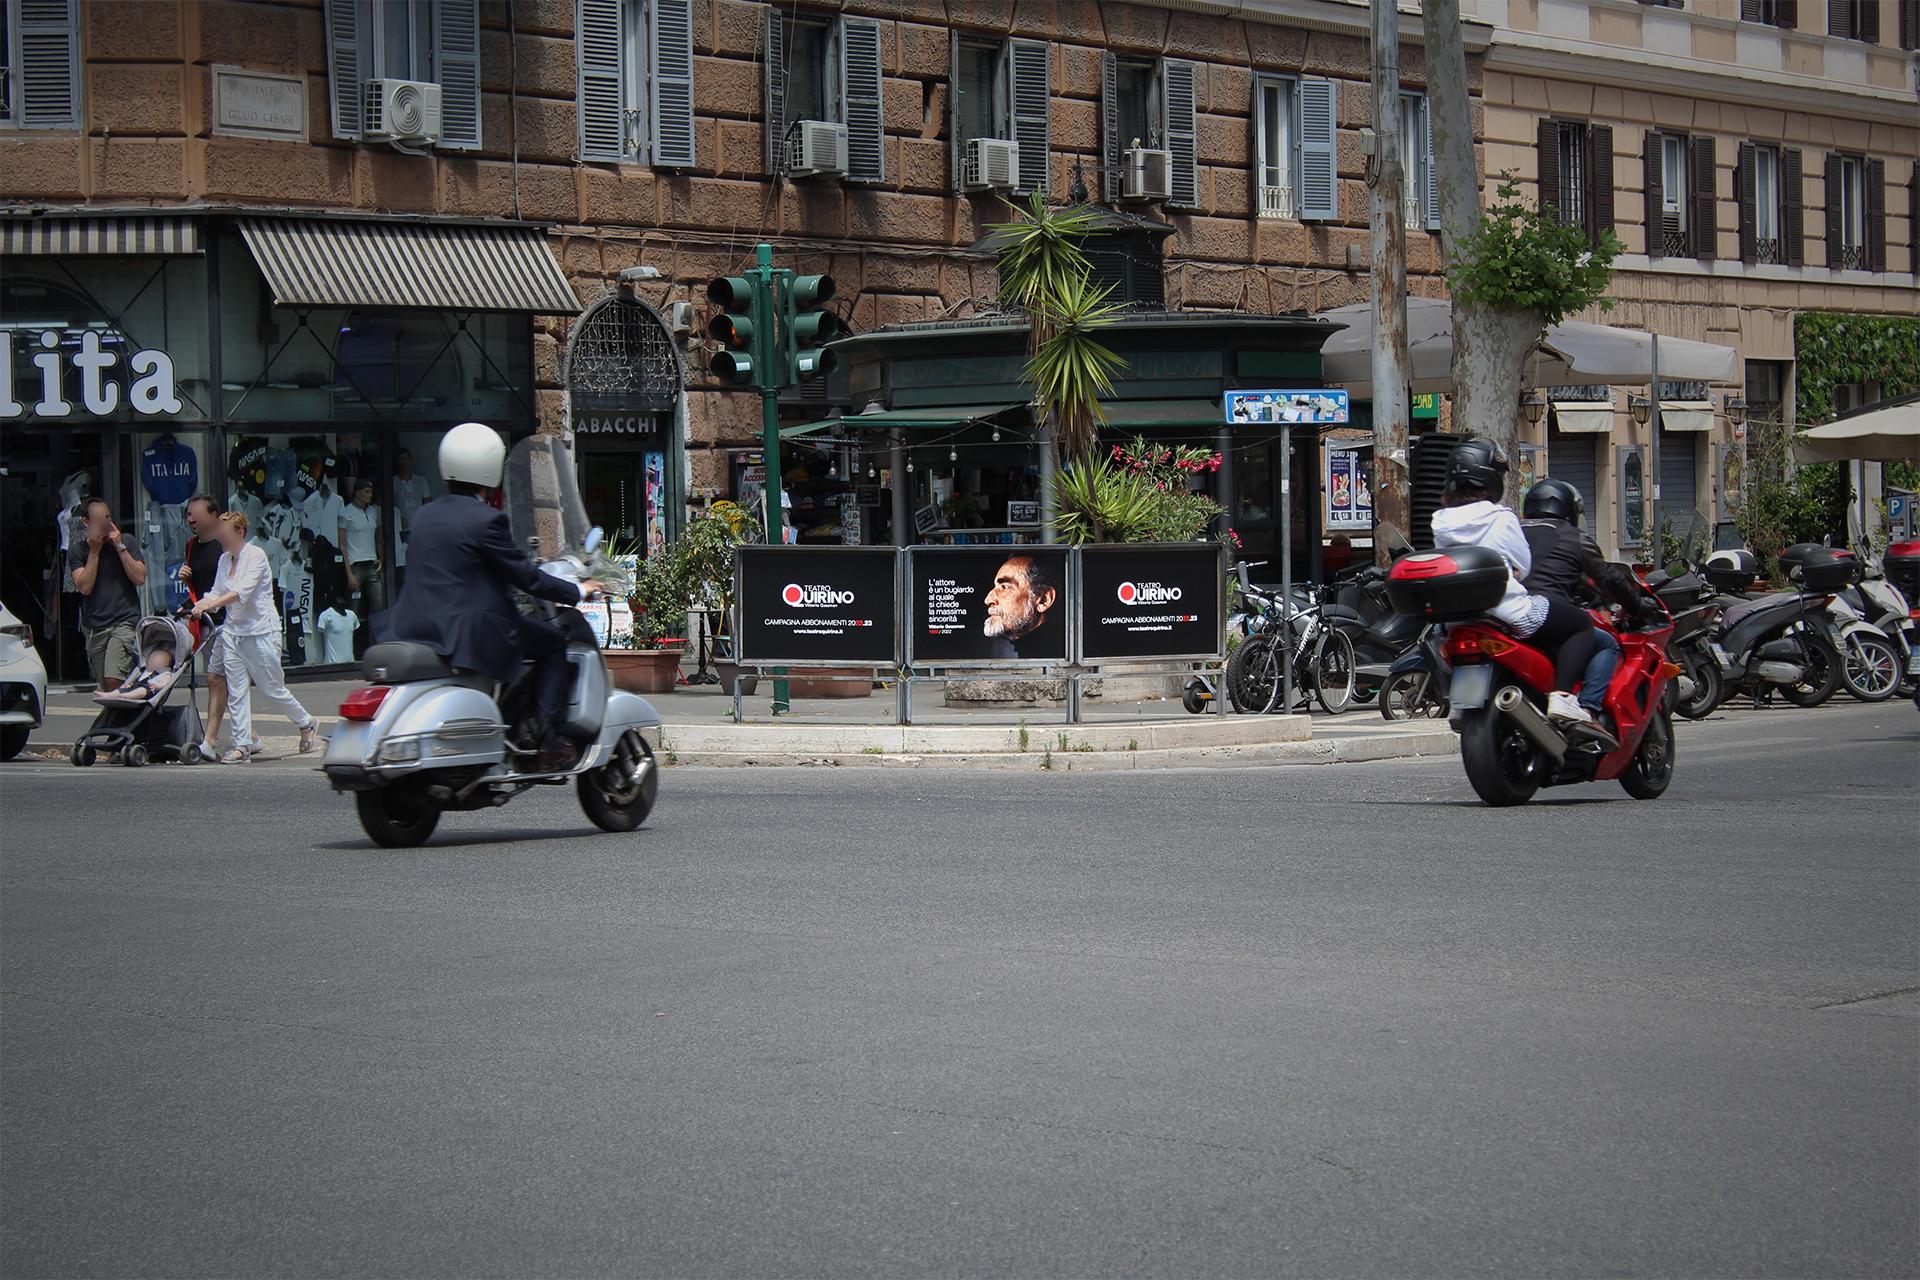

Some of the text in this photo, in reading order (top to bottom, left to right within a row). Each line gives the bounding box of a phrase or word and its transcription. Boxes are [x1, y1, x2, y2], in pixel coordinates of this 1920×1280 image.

[571, 417, 657, 433] ABACCHI
[238, 449, 259, 469] NASA
[296, 470, 317, 491] NASA
[782, 583, 855, 608] QUIRINO
[804, 584, 831, 592] TEATRO
[944, 586, 974, 595] bugiardo
[1117, 581, 1182, 606] QUIRINO
[299, 578, 311, 615] NASA
[935, 594, 955, 602] quale
[764, 618, 801, 626] CAMPAGNA
[1134, 615, 1175, 623] ABBONAMENTI
